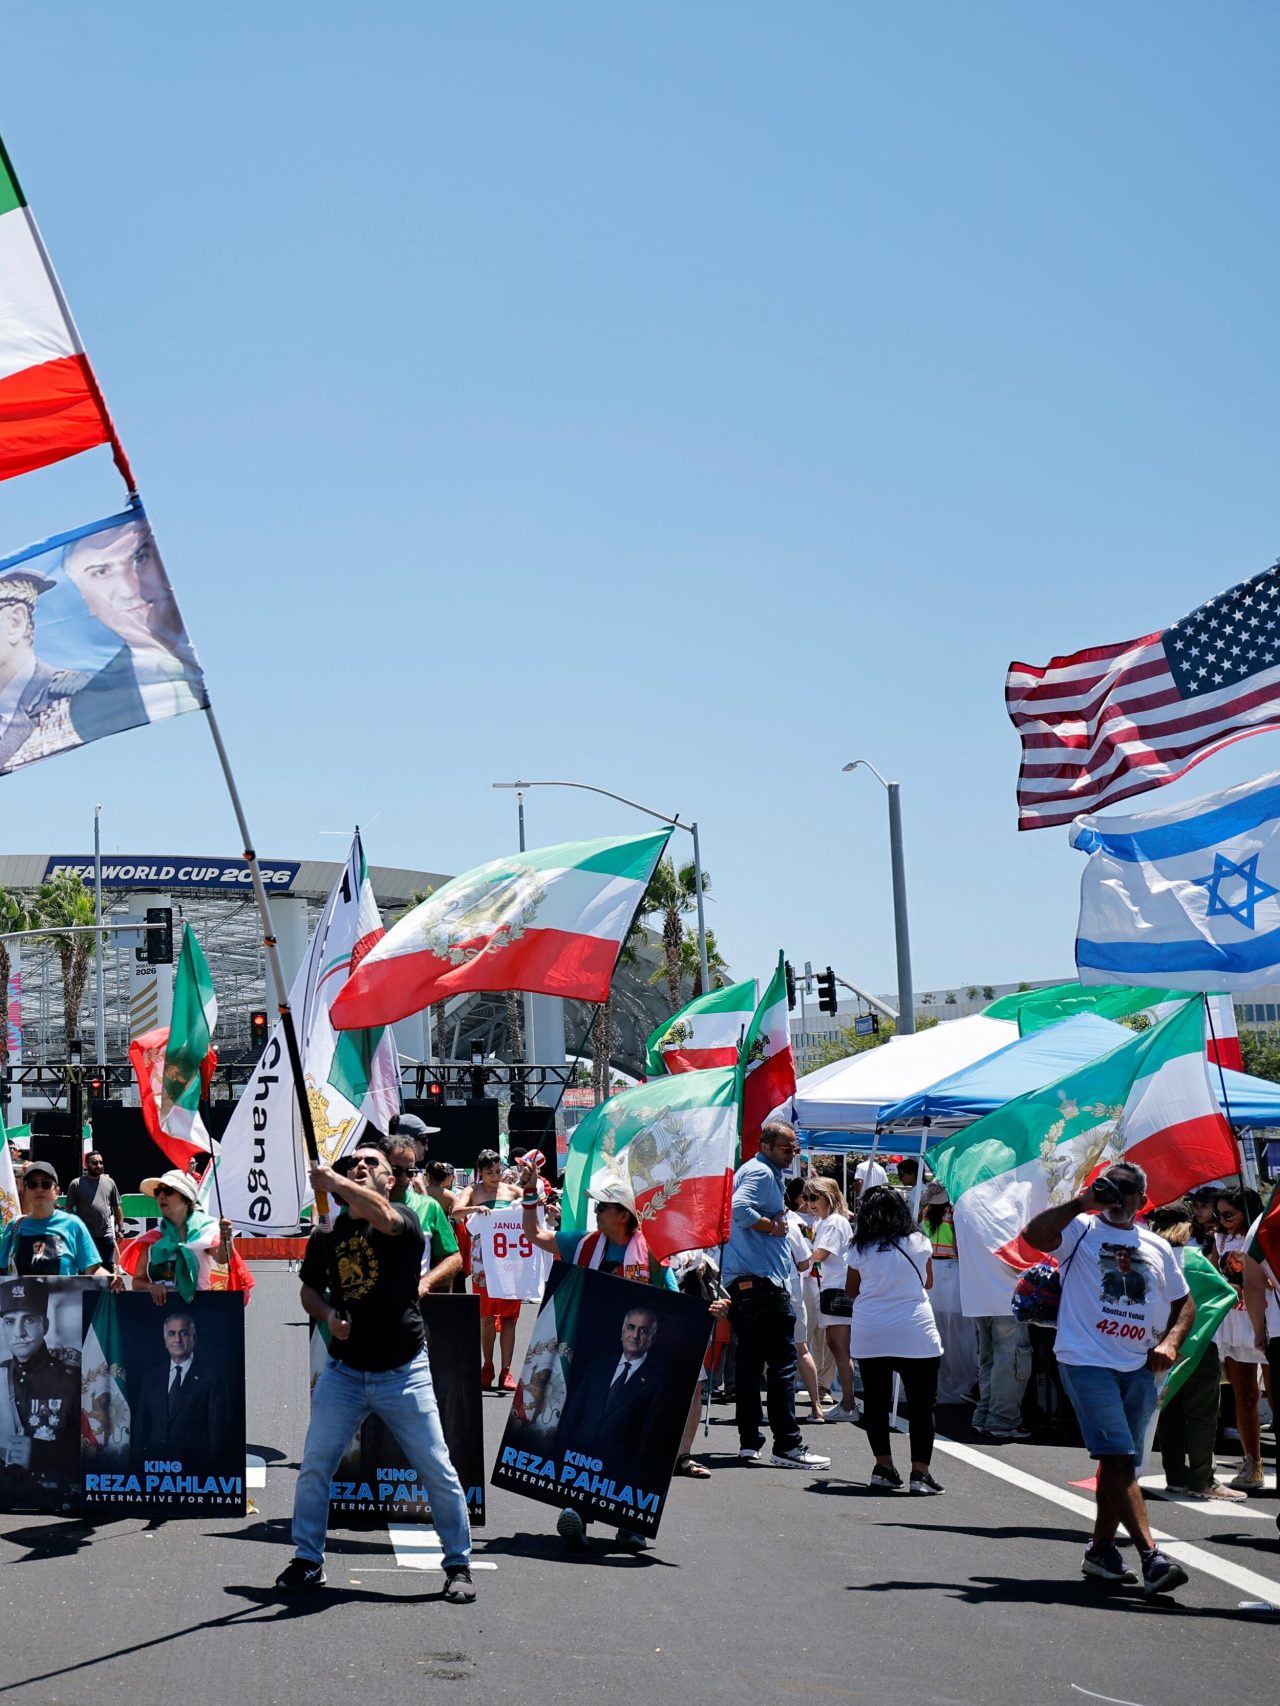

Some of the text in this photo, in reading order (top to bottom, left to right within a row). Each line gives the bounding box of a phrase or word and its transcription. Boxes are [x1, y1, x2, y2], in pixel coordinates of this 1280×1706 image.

[101, 865, 175, 881] WORLD
[178, 867, 219, 881] CUP
[220, 868, 291, 883] 2026
[136, 968, 157, 976] 2026
[247, 1036, 281, 1222] Change
[493, 1222, 524, 1230] JANUA
[493, 1232, 534, 1258] 8-9
[1096, 1319, 1146, 1340] 42,000
[144, 1460, 182, 1473] KING
[564, 1450, 603, 1472] KING
[85, 1474, 242, 1494] REZA PAHLAVI
[376, 1468, 417, 1481] KING
[501, 1446, 660, 1513] REZA PAHLAVI
[86, 1494, 173, 1503] ALTERNATIVE
[180, 1495, 204, 1504] FOR
[329, 1482, 374, 1501] EZA
[499, 1466, 655, 1524] ALTERNATIVE FOR IRAN
[332, 1502, 432, 1513] TERNATIVE FO
